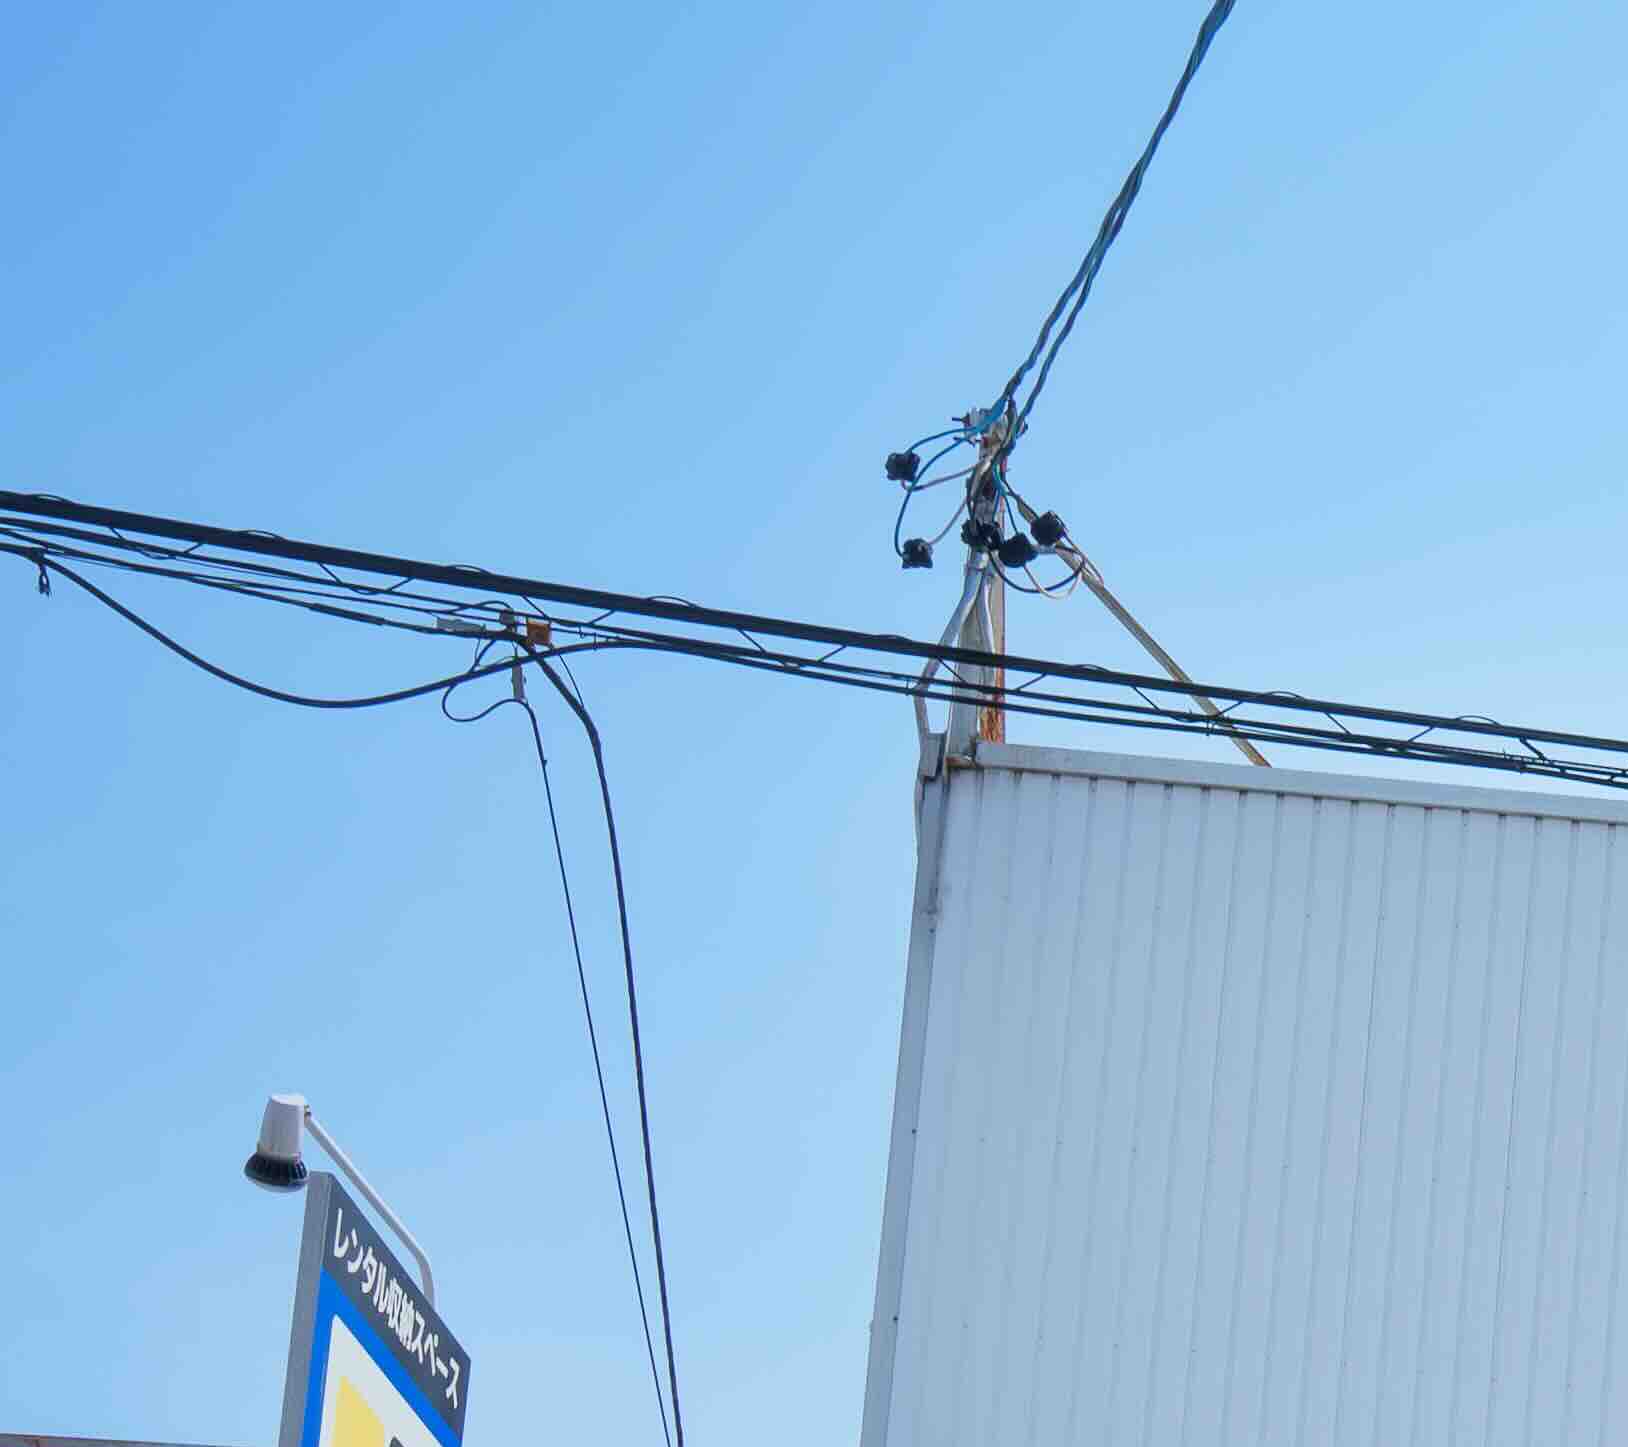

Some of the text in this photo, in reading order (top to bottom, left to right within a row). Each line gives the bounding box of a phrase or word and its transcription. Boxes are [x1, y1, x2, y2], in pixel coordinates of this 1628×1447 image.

[333, 1208, 461, 1408] レンタル収納スペース
